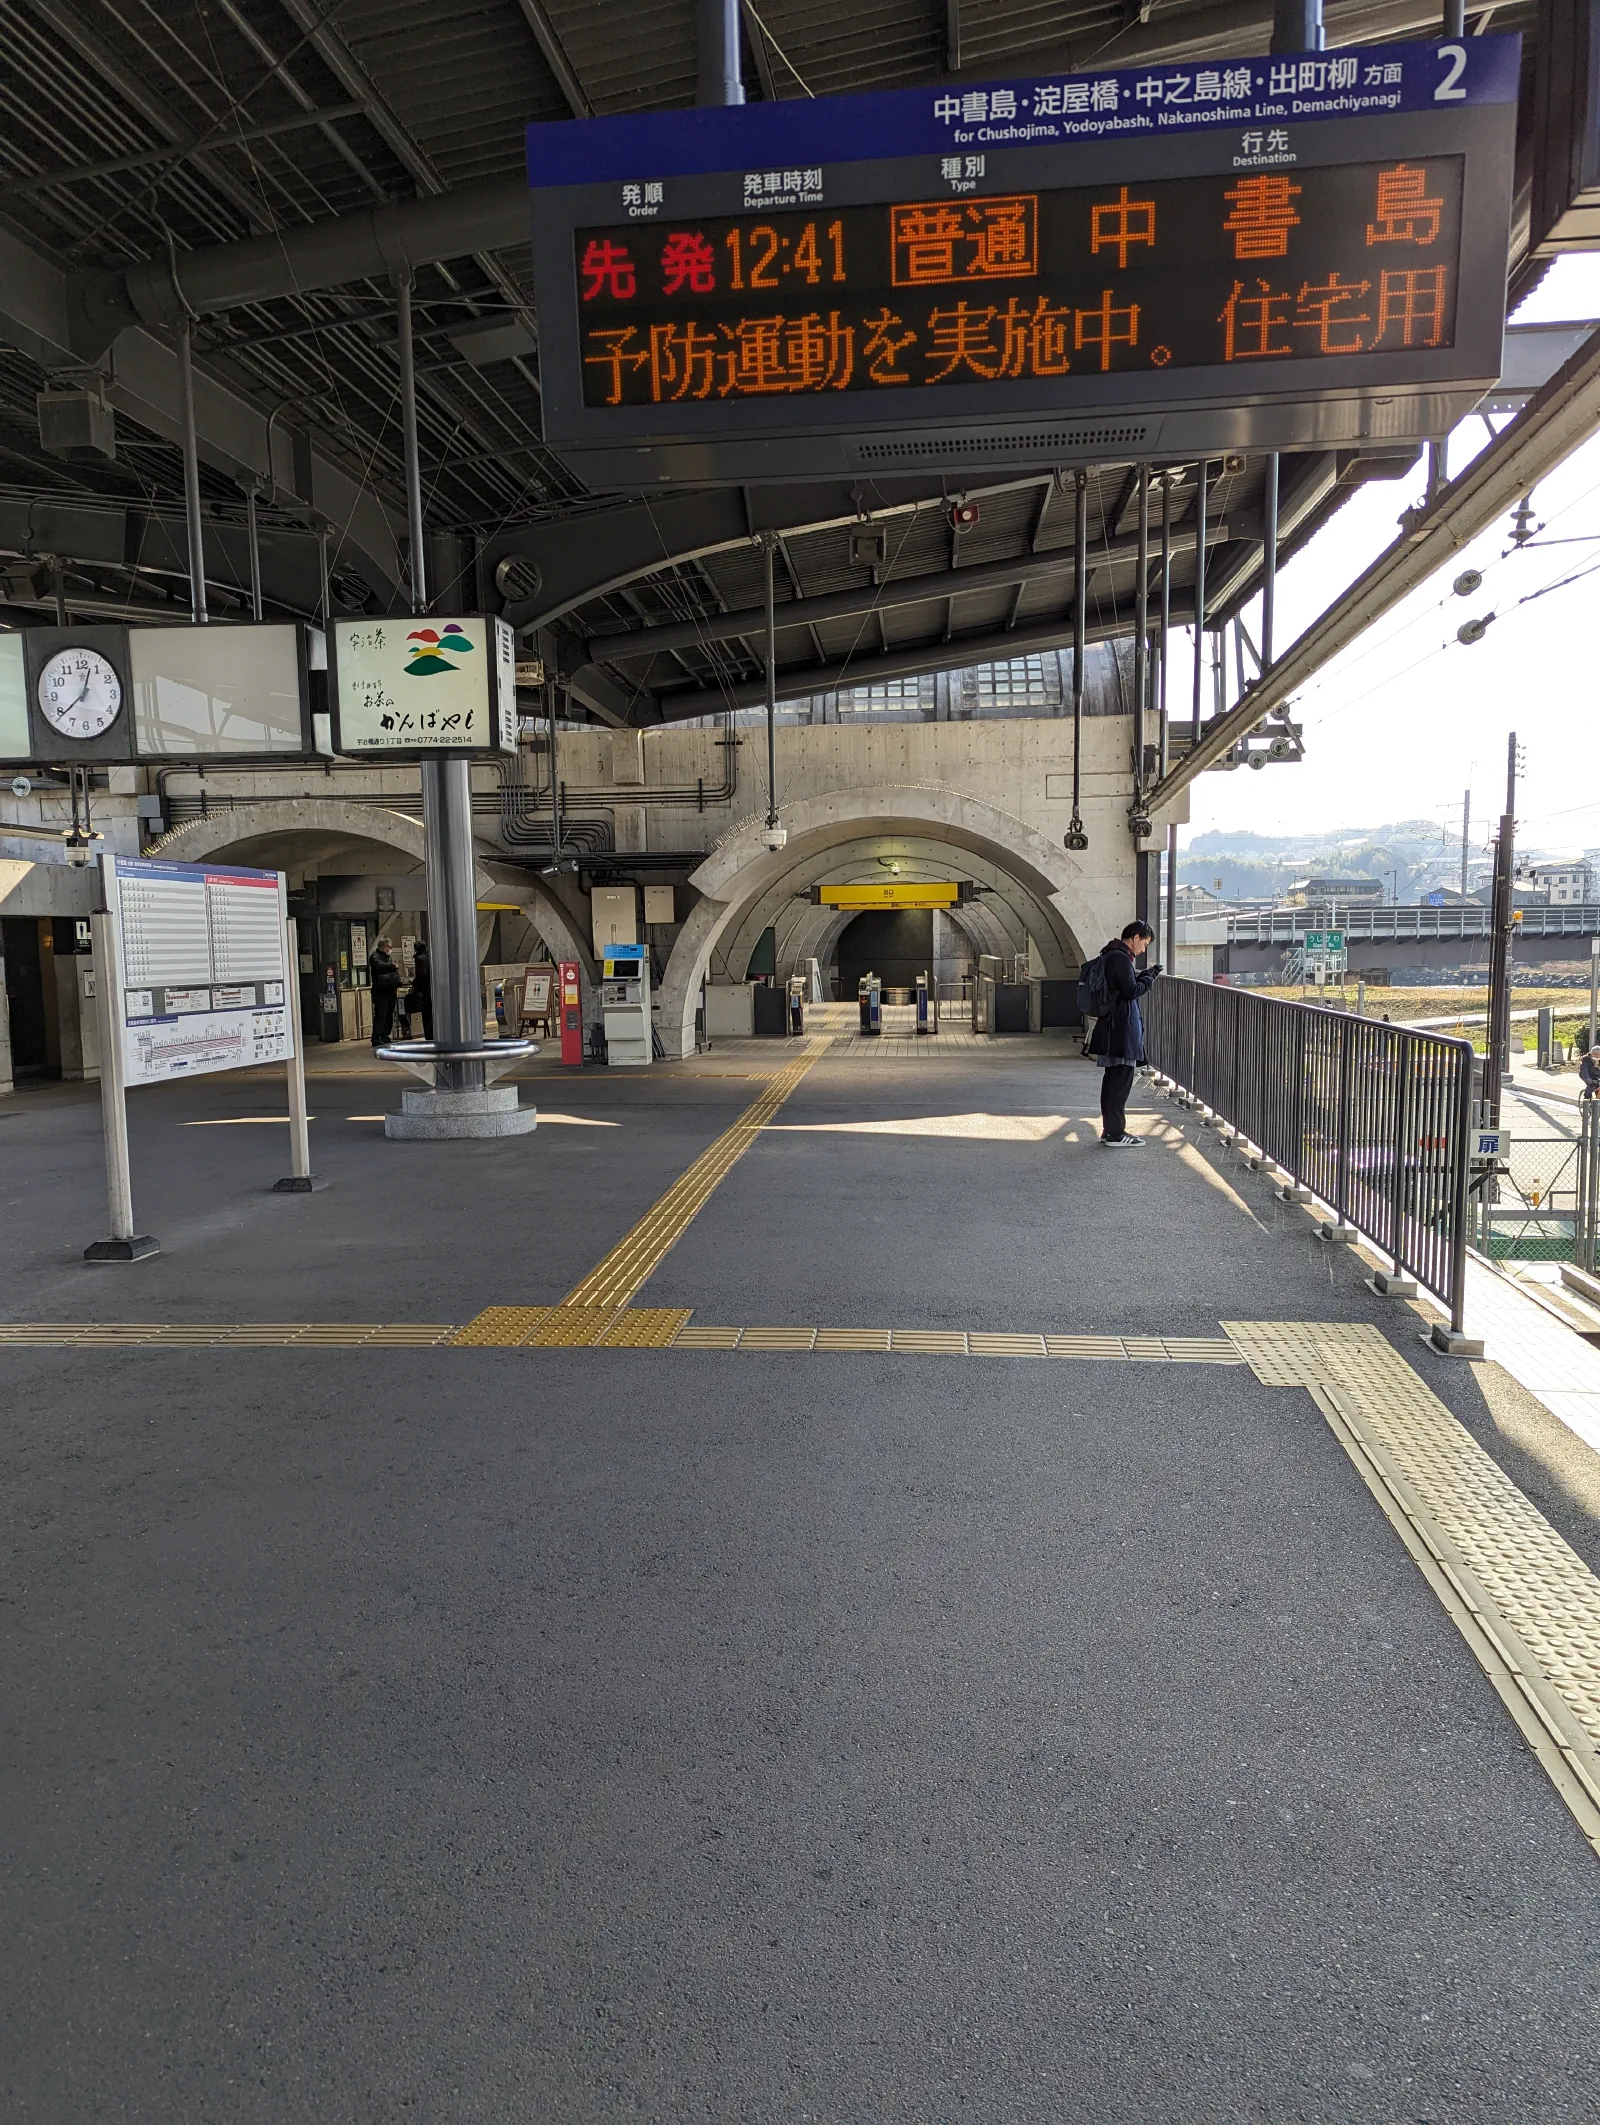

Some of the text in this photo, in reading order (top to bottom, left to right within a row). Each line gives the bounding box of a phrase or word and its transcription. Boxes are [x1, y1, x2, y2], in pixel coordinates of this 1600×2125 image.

[1433, 44, 1468, 101] 2
[934, 57, 1403, 125] 中書島・淀屋橋・中之島線・出町柳 方面
[953, 91, 1401, 143] for Chushojima, Yodoyabashi, Nakanoshima Line, Demachiyanagi
[1241, 129, 1289, 154] 行先
[1233, 151, 1297, 167] Destination
[940, 154, 986, 180] 種別
[743, 168, 824, 196] 発車時刻
[950, 178, 977, 193] Type
[621, 182, 664, 207] 発順
[743, 190, 824, 209] Departure Time
[628, 204, 658, 218] Order
[726, 220, 847, 290] 12:41
[897, 203, 1032, 280] 普通
[584, 264, 1449, 404] 予防運動を実施中。 住宅用
[62, 666, 72, 674] 11
[75, 660, 88, 669] 12
[94, 665, 100, 674] 1
[52, 677, 64, 687] 10
[104, 675, 112, 684] 2
[51, 692, 58, 701] 9
[110, 689, 116, 699] 3
[363, 690, 395, 708] お茶の
[57, 707, 64, 716] 8
[106, 705, 113, 714] 4
[69, 718, 76, 727] 7
[83, 721, 89, 730] 6
[97, 717, 104, 727] 5
[379, 708, 475, 733] かんばやし
[1478, 1135, 1500, 1153] 扉
